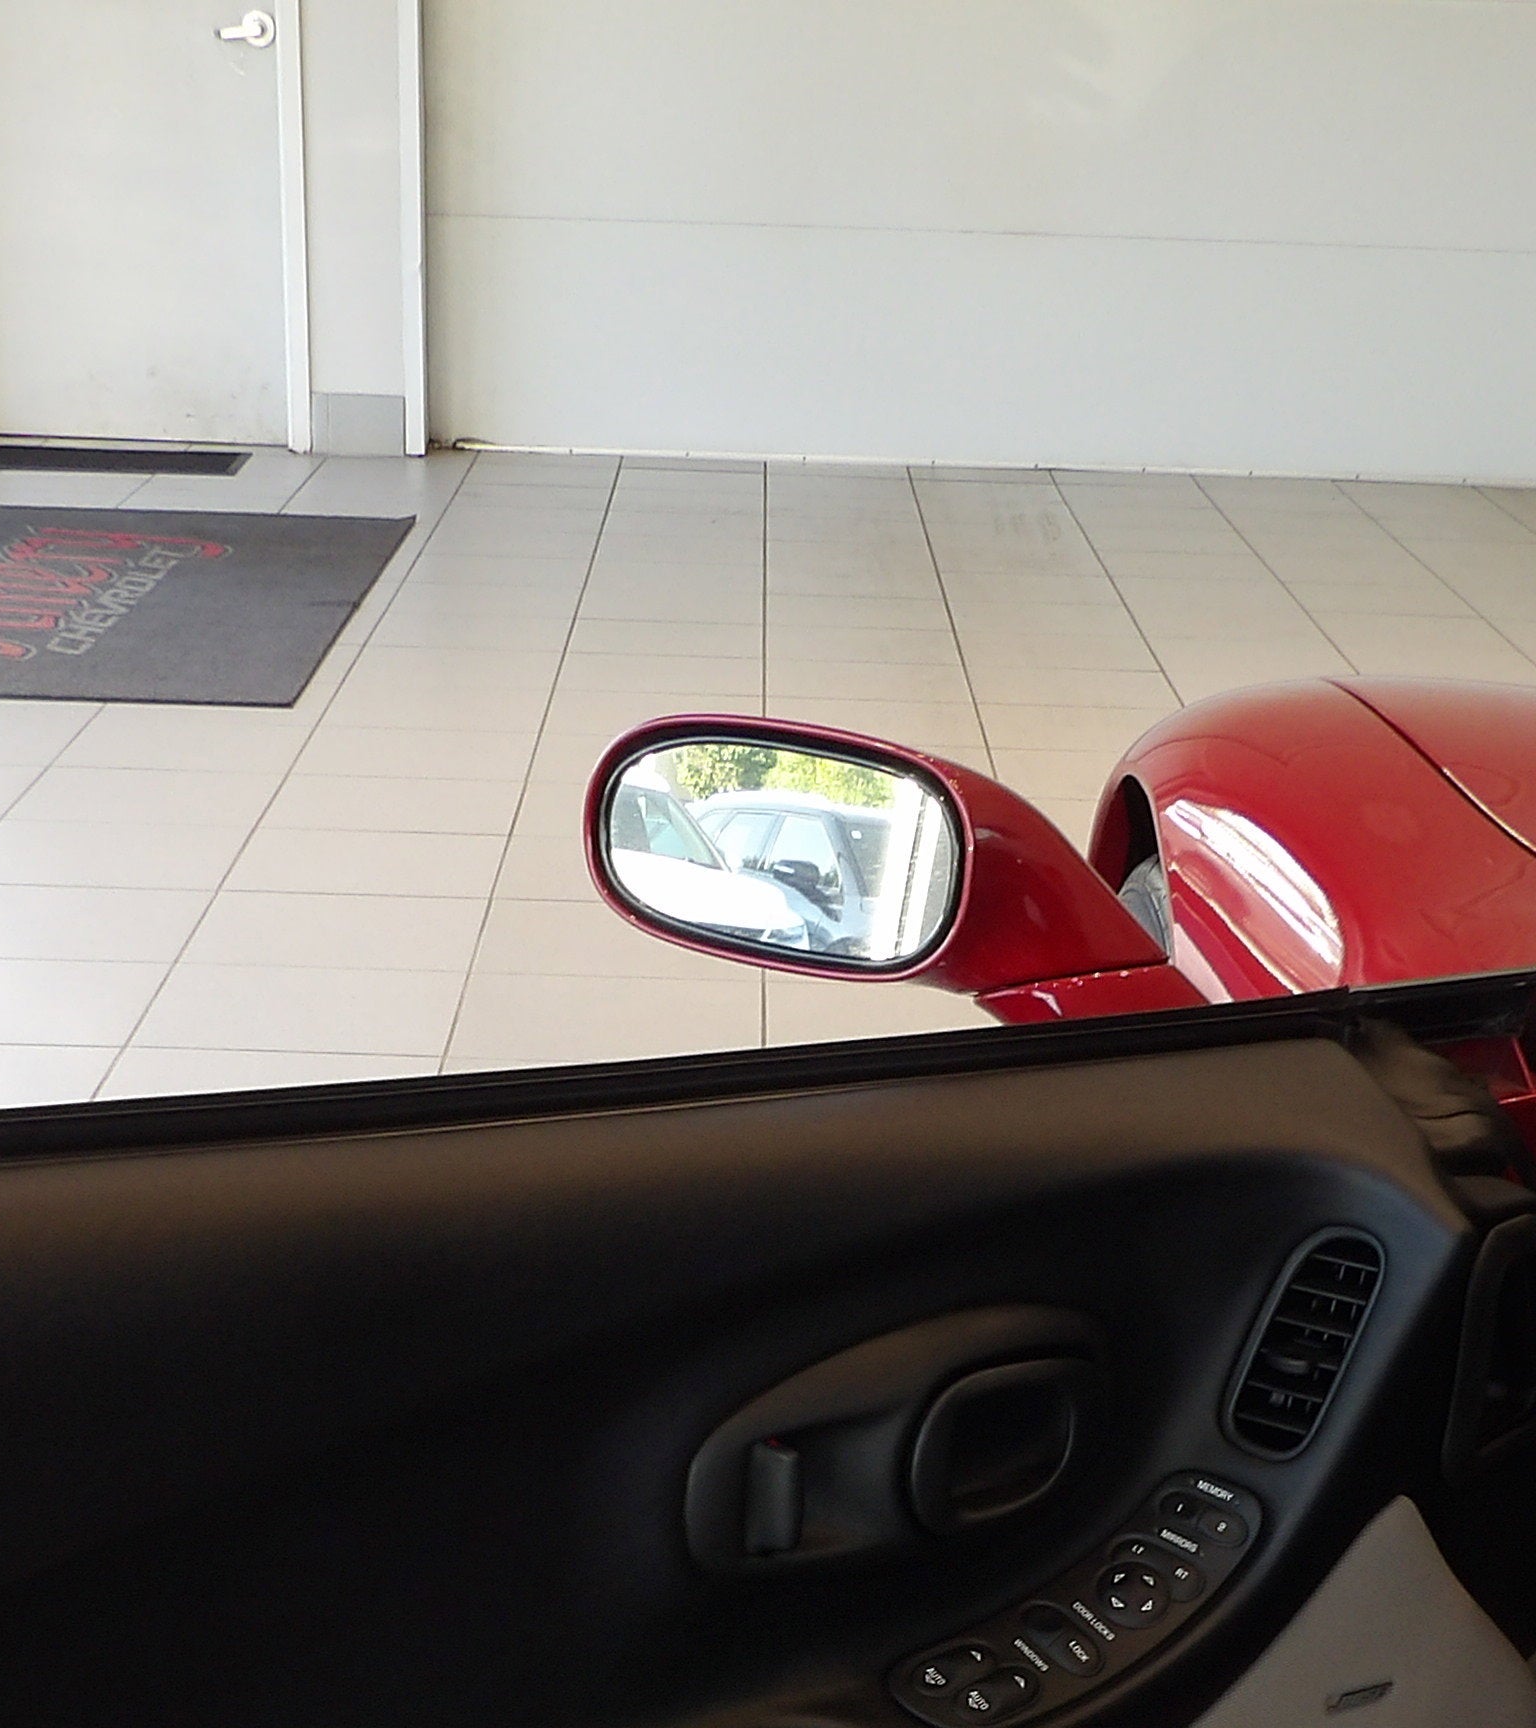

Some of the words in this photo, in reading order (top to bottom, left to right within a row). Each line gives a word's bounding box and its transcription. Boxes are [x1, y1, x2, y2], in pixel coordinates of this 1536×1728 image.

[47, 546, 189, 656] CHEVROLET
[1196, 1480, 1234, 1501] MEMORY
[1160, 1528, 1199, 1553] MIRRORS
[1174, 1567, 1189, 1580] RT
[1072, 1601, 1094, 1621] DOOR
[1090, 1618, 1116, 1642] LOCKS
[1014, 1638, 1050, 1672] WINDOWS
[1068, 1640, 1090, 1662] LOCK
[926, 1667, 946, 1686] AUTO
[969, 1690, 990, 1710] AUTO
